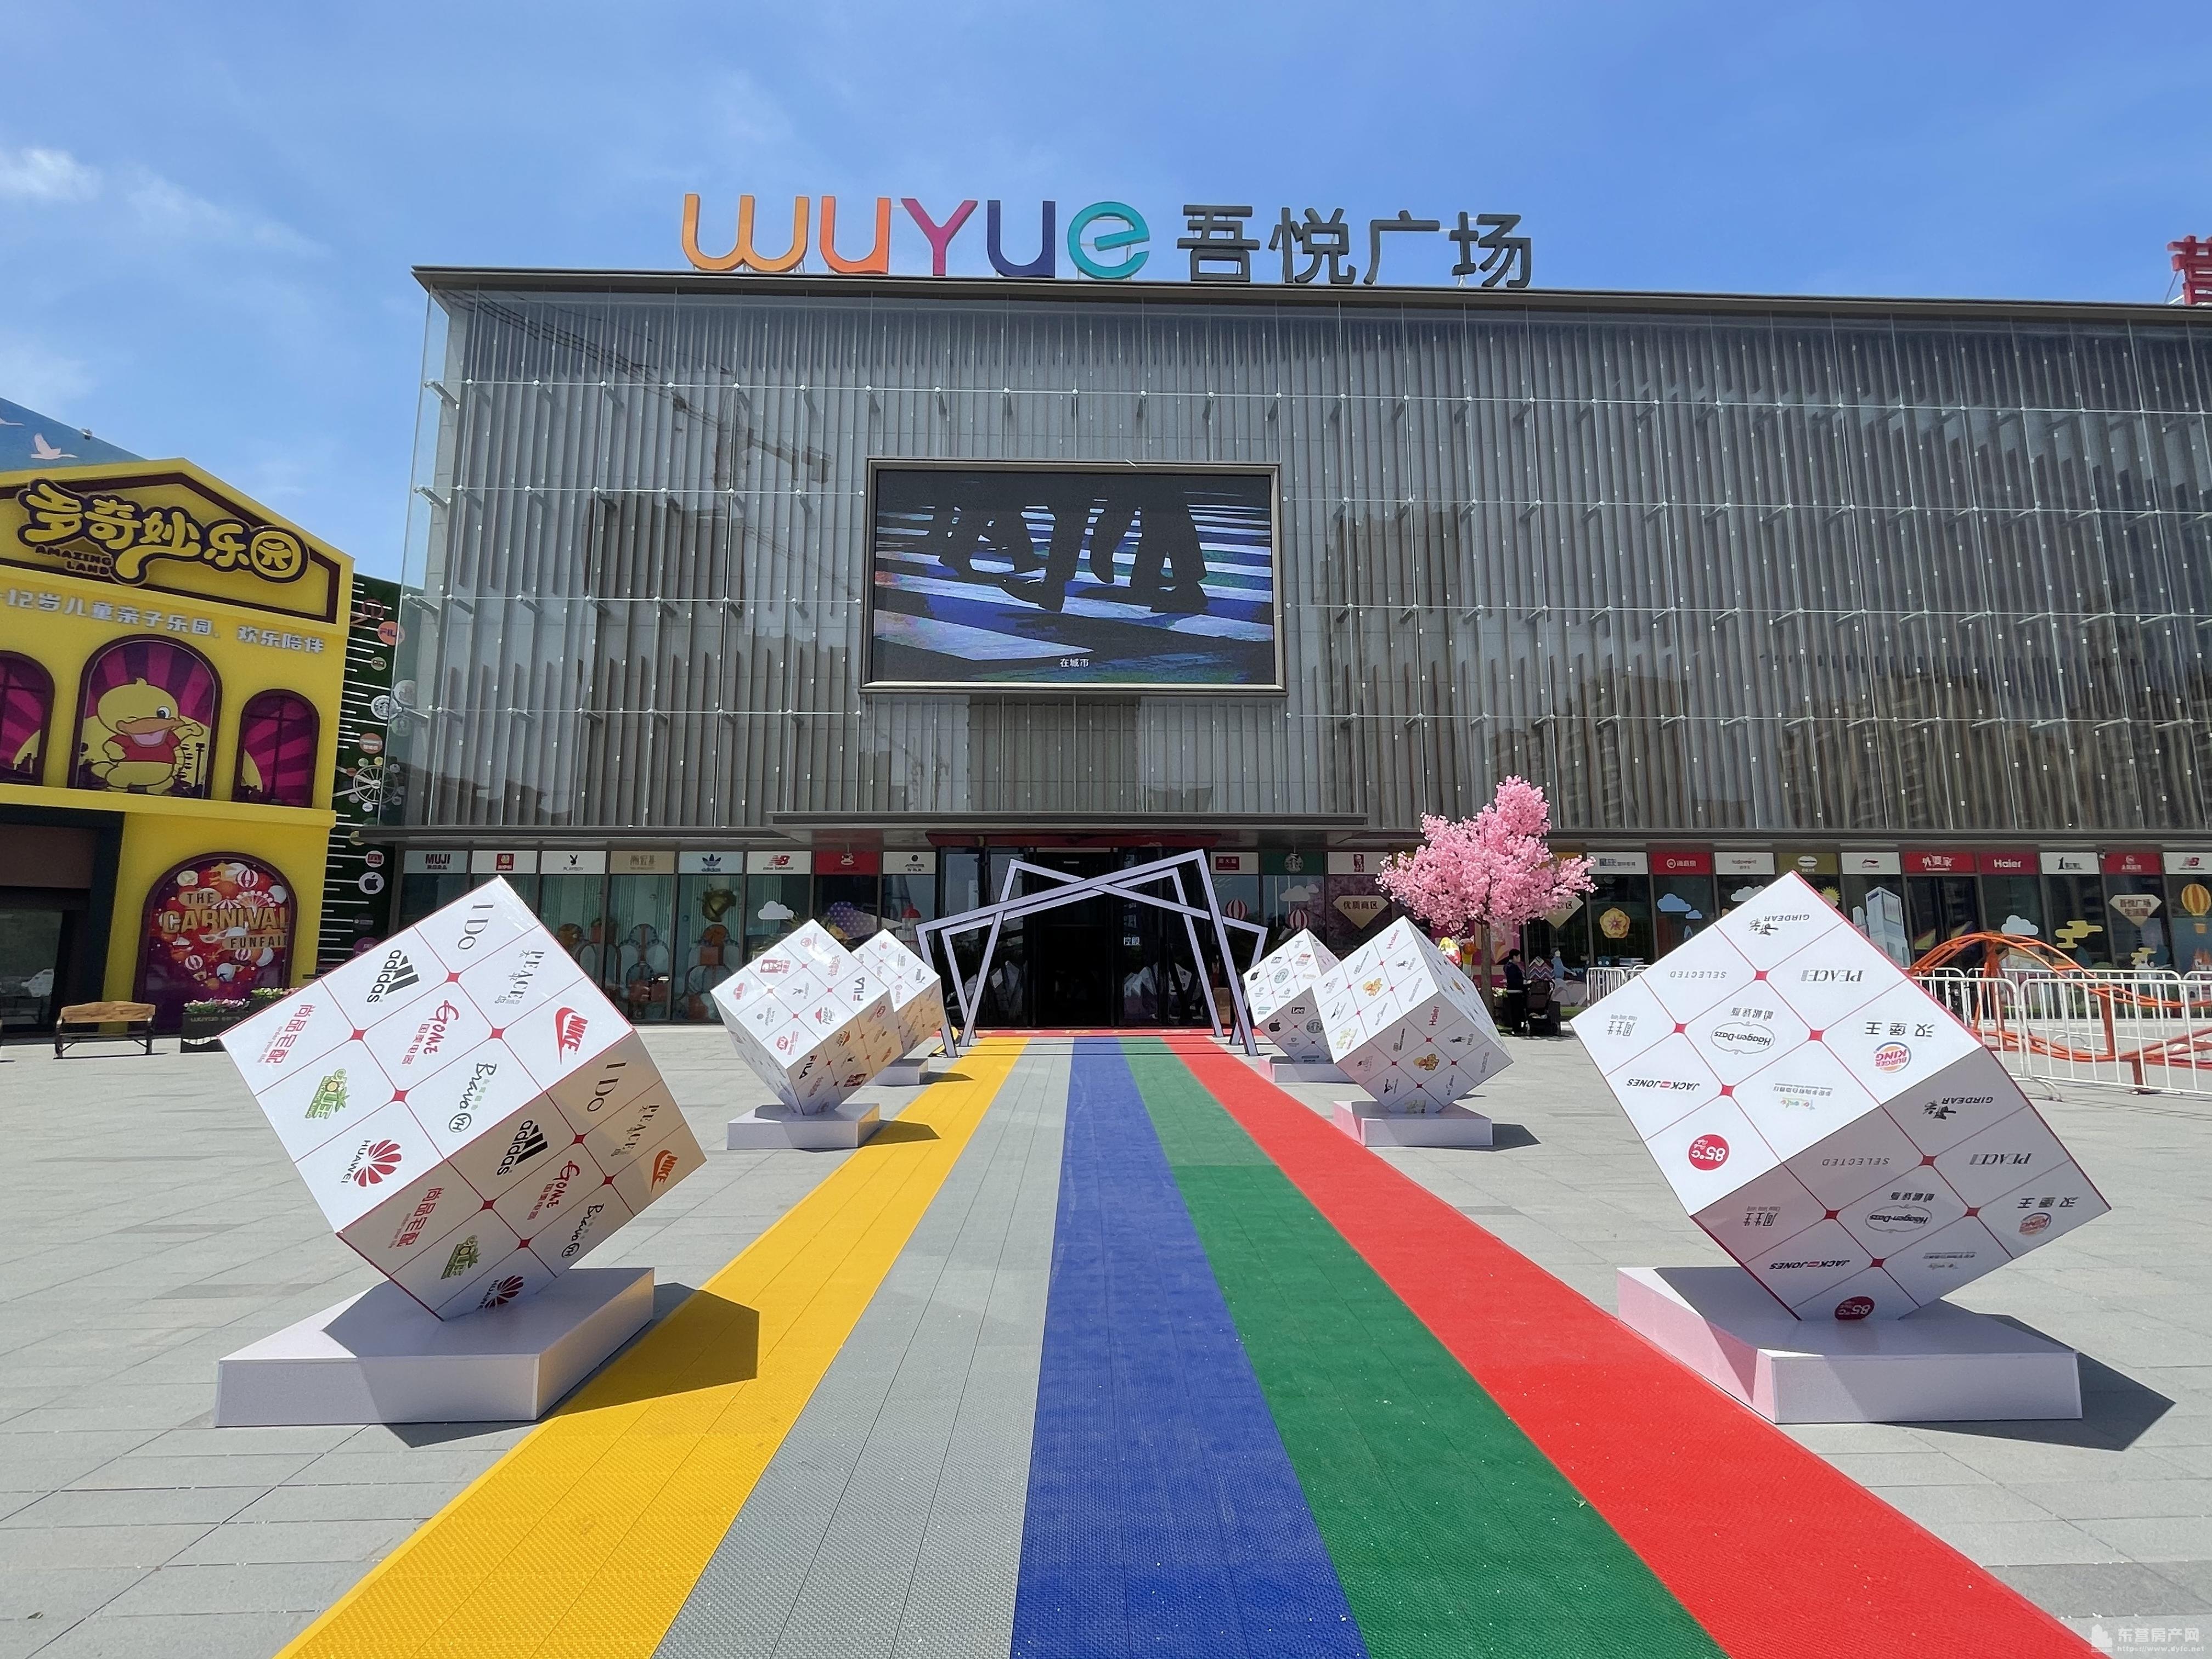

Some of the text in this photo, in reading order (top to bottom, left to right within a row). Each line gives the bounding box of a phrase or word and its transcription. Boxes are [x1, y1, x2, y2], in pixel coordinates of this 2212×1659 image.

[1177, 205, 1534, 289] 吾悦广场
[21, 481, 305, 583] 多奇妙乐园
[35, 545, 112, 565] AMAZING
[66, 561, 110, 575] LAND
[237, 625, 324, 653] 欢乐陪伴
[425, 854, 451, 865] MUJI
[1994, 859, 2022, 868] Haier
[187, 892, 215, 904] THE
[1343, 900, 1378, 910] 优质商区
[162, 907, 287, 934] CARNIVAL
[1764, 913, 1810, 922] GIRDEAR
[458, 917, 490, 950] DO
[1386, 929, 1400, 950] Haier
[366, 949, 402, 1003] adidas
[1669, 970, 1728, 979] SELECTED
[853, 977, 866, 1002] FILA
[1429, 1006, 1440, 1026] Haier
[265, 1003, 316, 1064] 尚品宅配
[561, 1014, 589, 1055] NIKE
[1606, 1020, 1635, 1037] 周生生
[1865, 1022, 1935, 1038] 汉堡王
[1875, 1048, 1908, 1061] KING
[1875, 1057, 1907, 1068] BURGER
[798, 1054, 818, 1080] FILA
[459, 1062, 497, 1110] Bravo
[586, 1061, 627, 1113] I DO
[496, 1119, 534, 1176] adidas
[341, 1139, 371, 1184] HUAWEI
[657, 1154, 679, 1185] NIKE
[1821, 1158, 1890, 1166] SELECTED
[396, 1187, 445, 1249] 尚品宅配
[1743, 1212, 1779, 1227] 周生生
